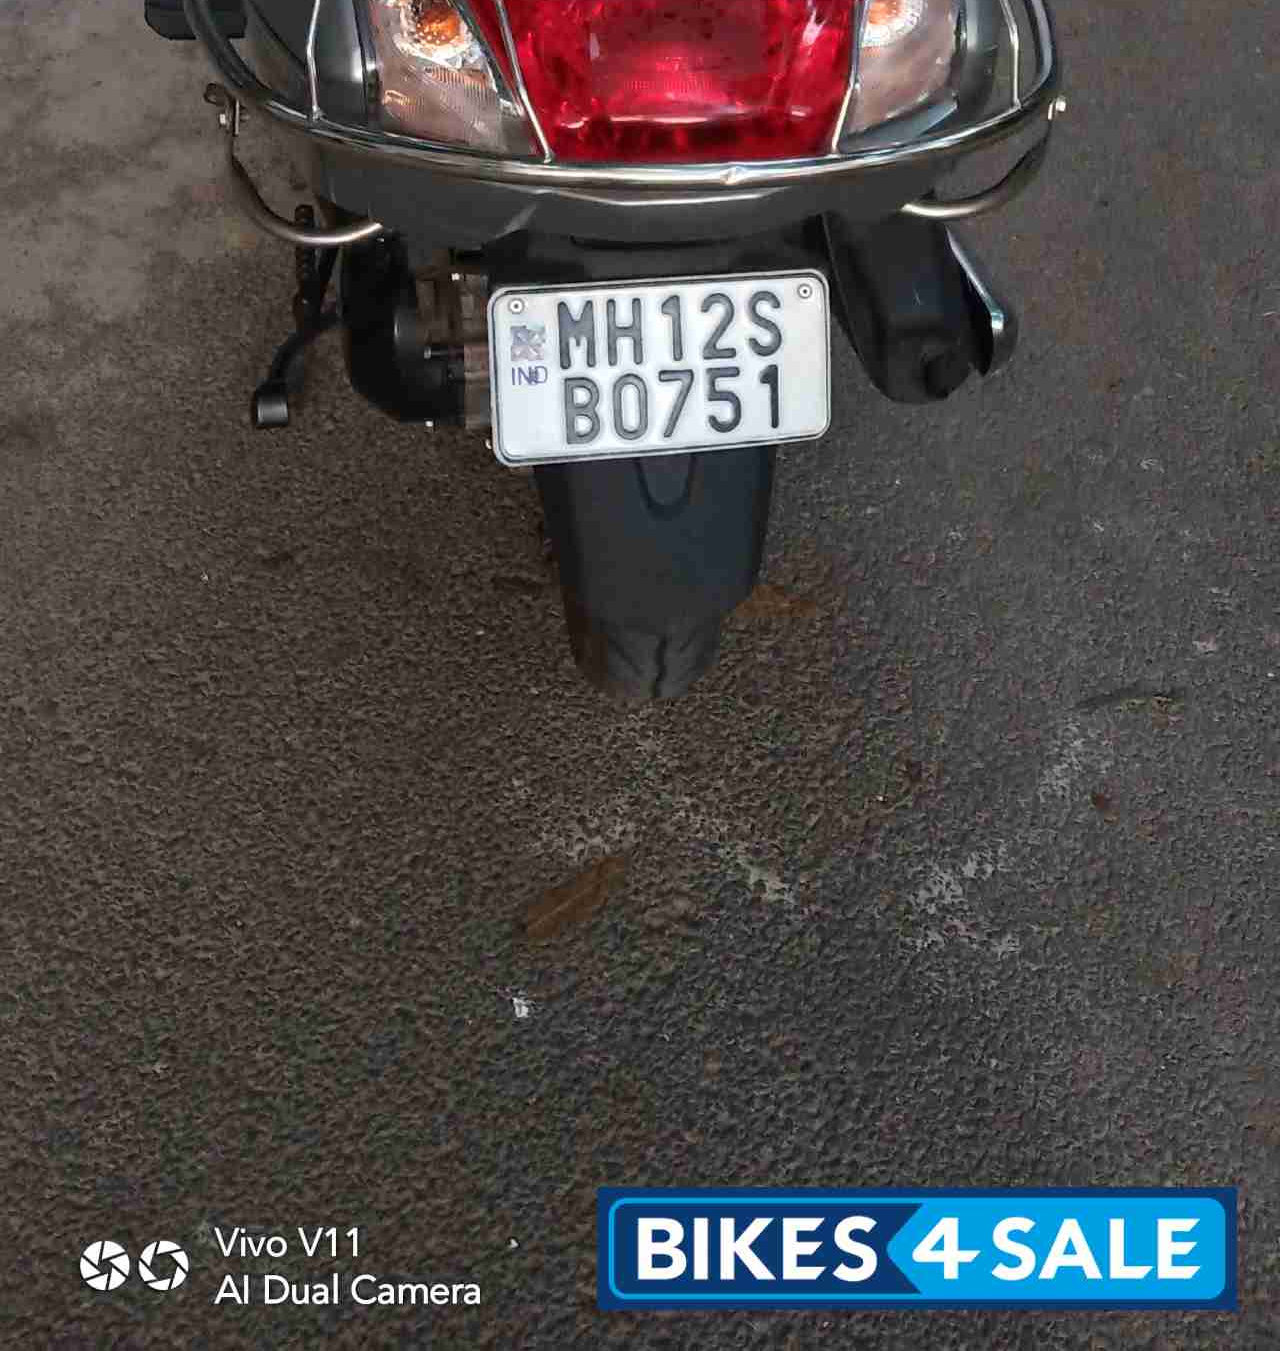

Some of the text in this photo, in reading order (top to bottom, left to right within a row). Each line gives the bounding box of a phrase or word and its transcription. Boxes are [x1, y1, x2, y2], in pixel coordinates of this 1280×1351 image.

[556, 290, 783, 370] MH12S
[511, 365, 548, 386] IND
[563, 364, 779, 444] B0751
